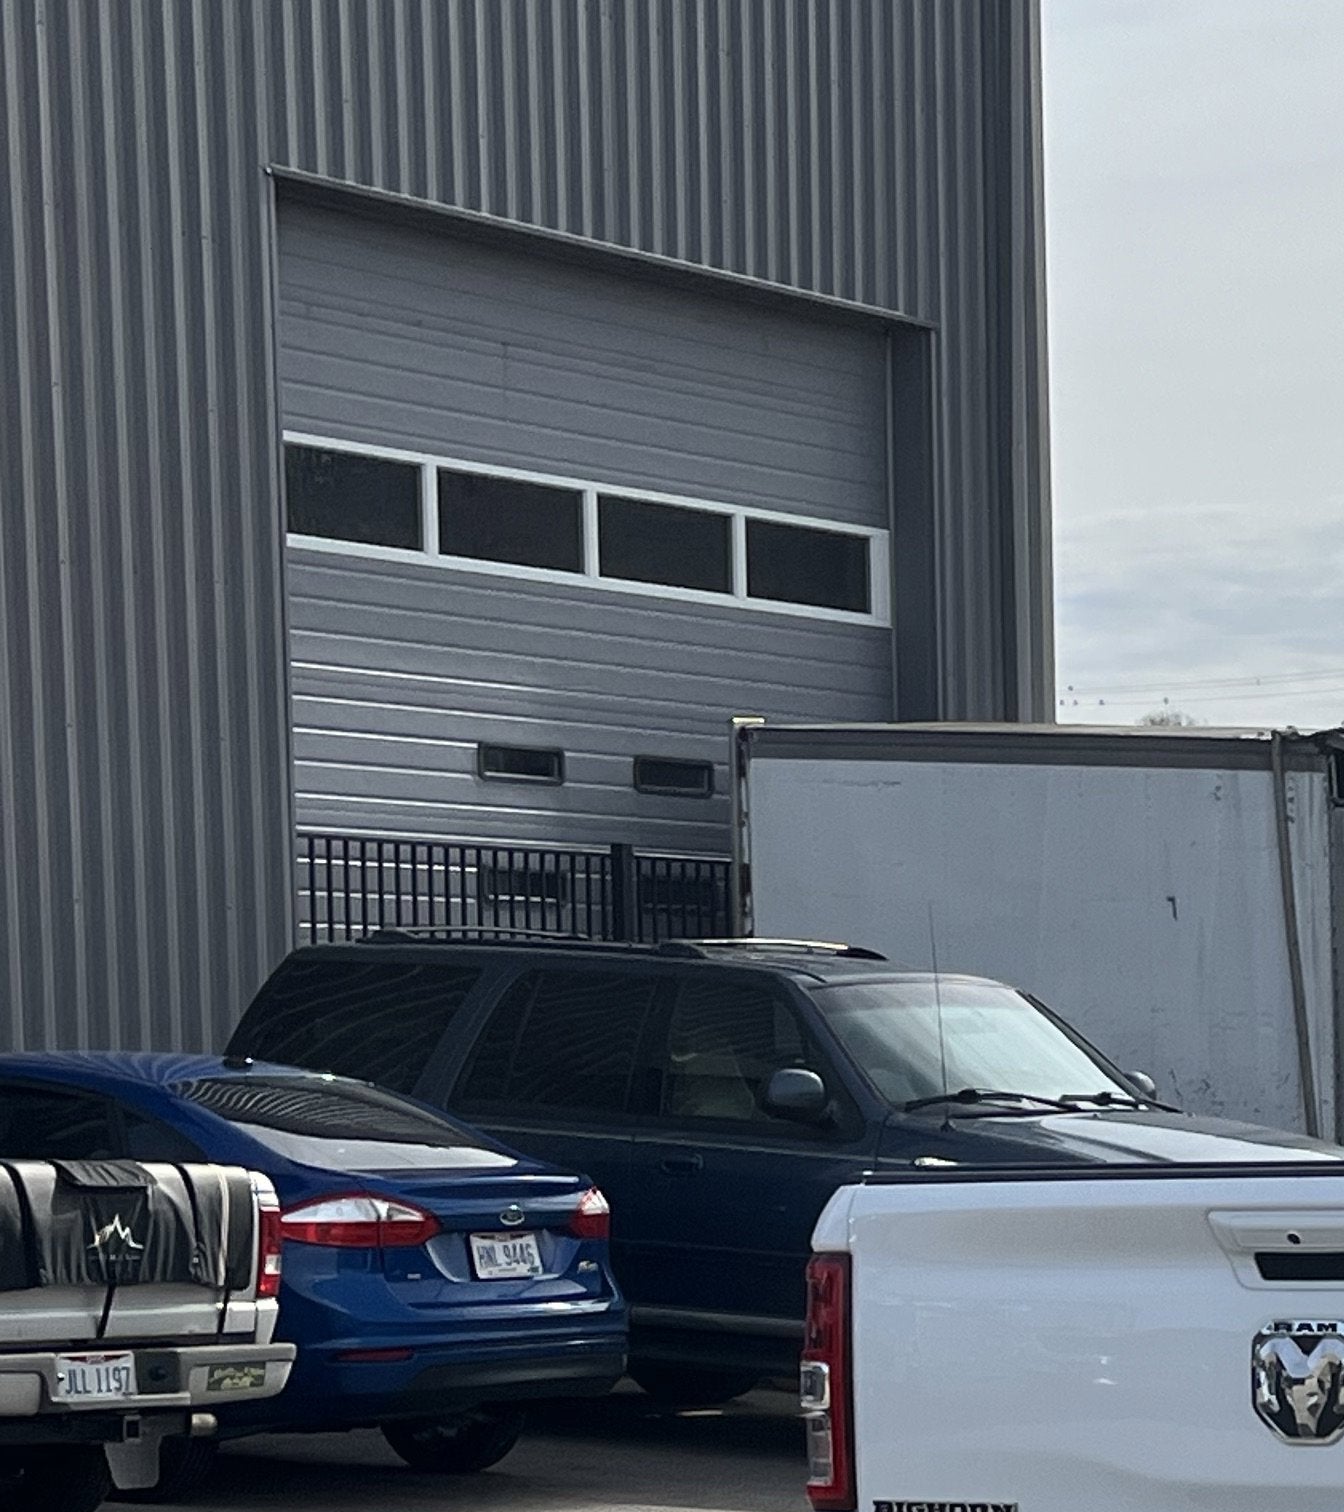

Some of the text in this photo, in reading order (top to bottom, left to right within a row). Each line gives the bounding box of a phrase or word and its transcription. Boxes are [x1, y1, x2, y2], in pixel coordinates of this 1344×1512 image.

[1273, 1322, 1338, 1333] RAM
[65, 1366, 131, 1395] JLL 1197
